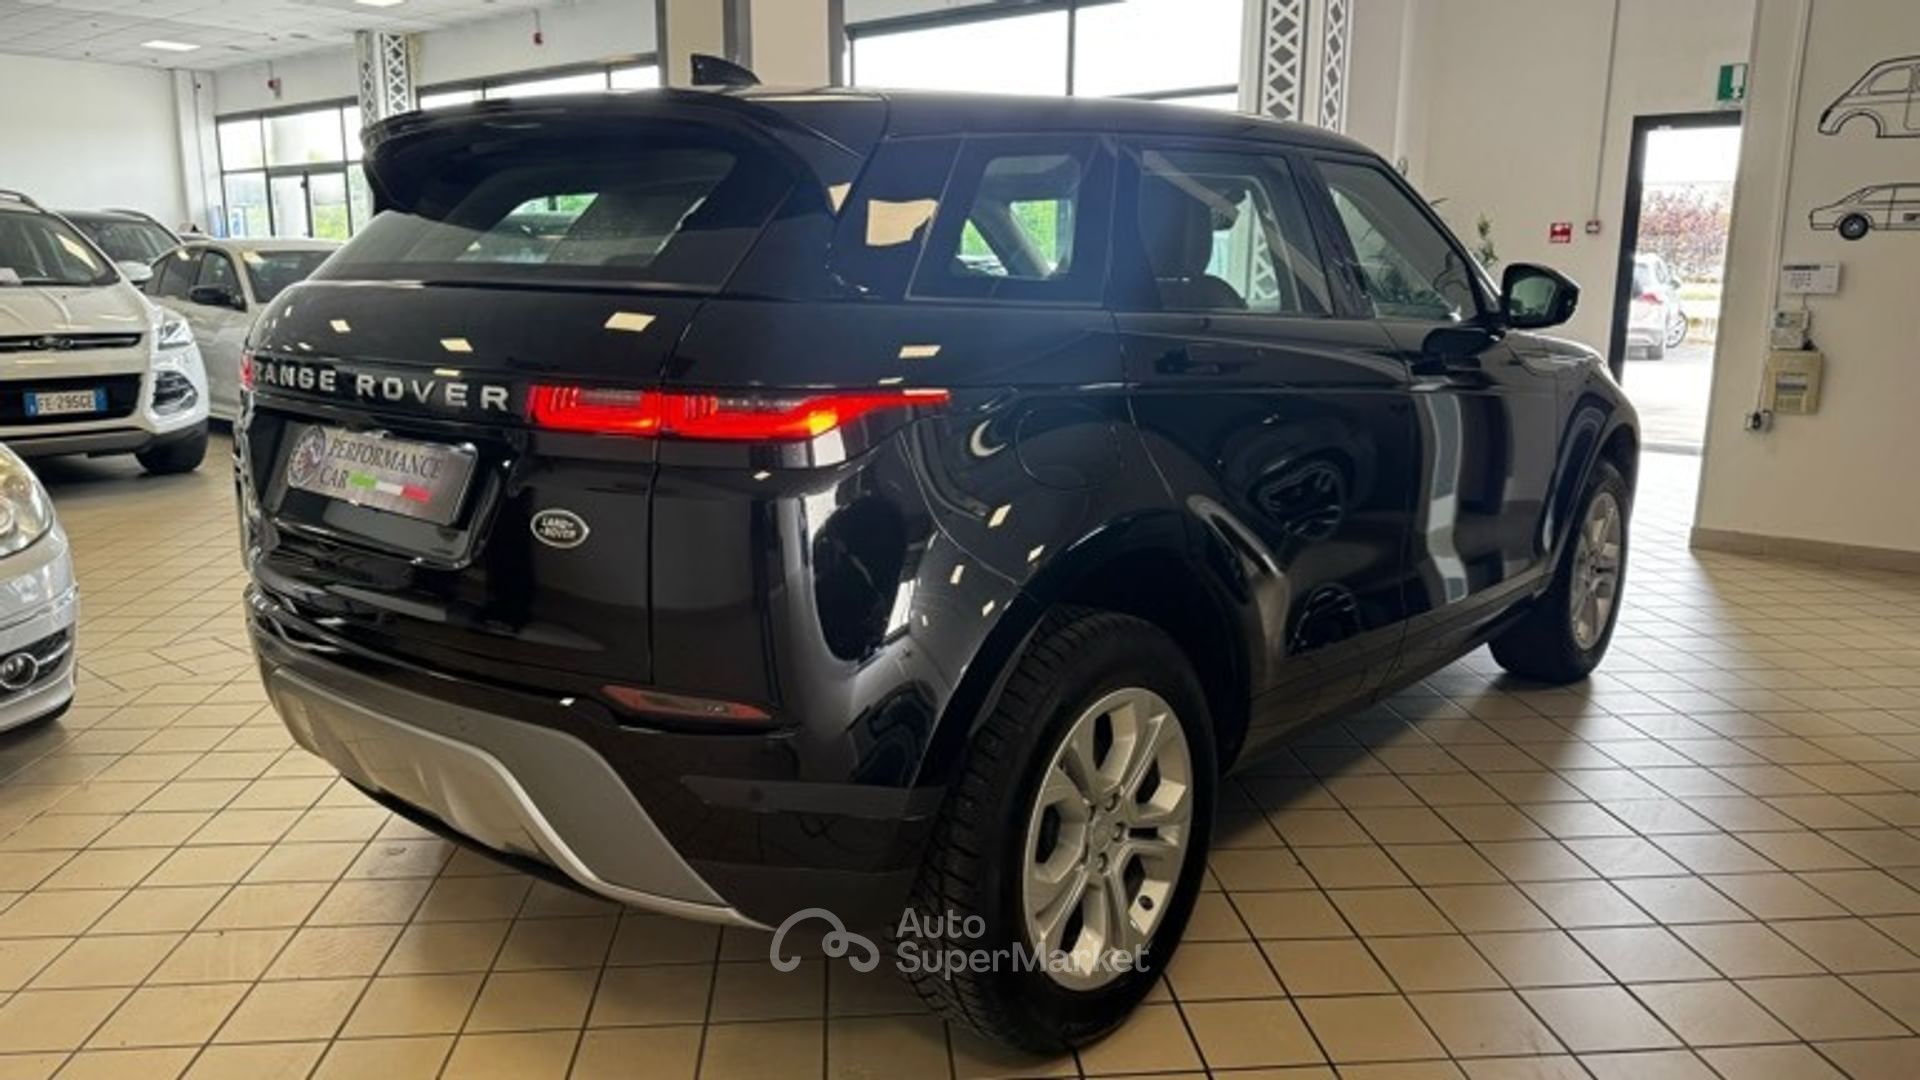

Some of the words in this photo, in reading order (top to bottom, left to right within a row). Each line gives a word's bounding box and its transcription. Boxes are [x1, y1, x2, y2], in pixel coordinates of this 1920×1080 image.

[254, 360, 337, 393] RANGE
[356, 374, 509, 412] ROVER
[319, 466, 349, 489] CAR
[327, 437, 443, 480] PERFORMANCE
